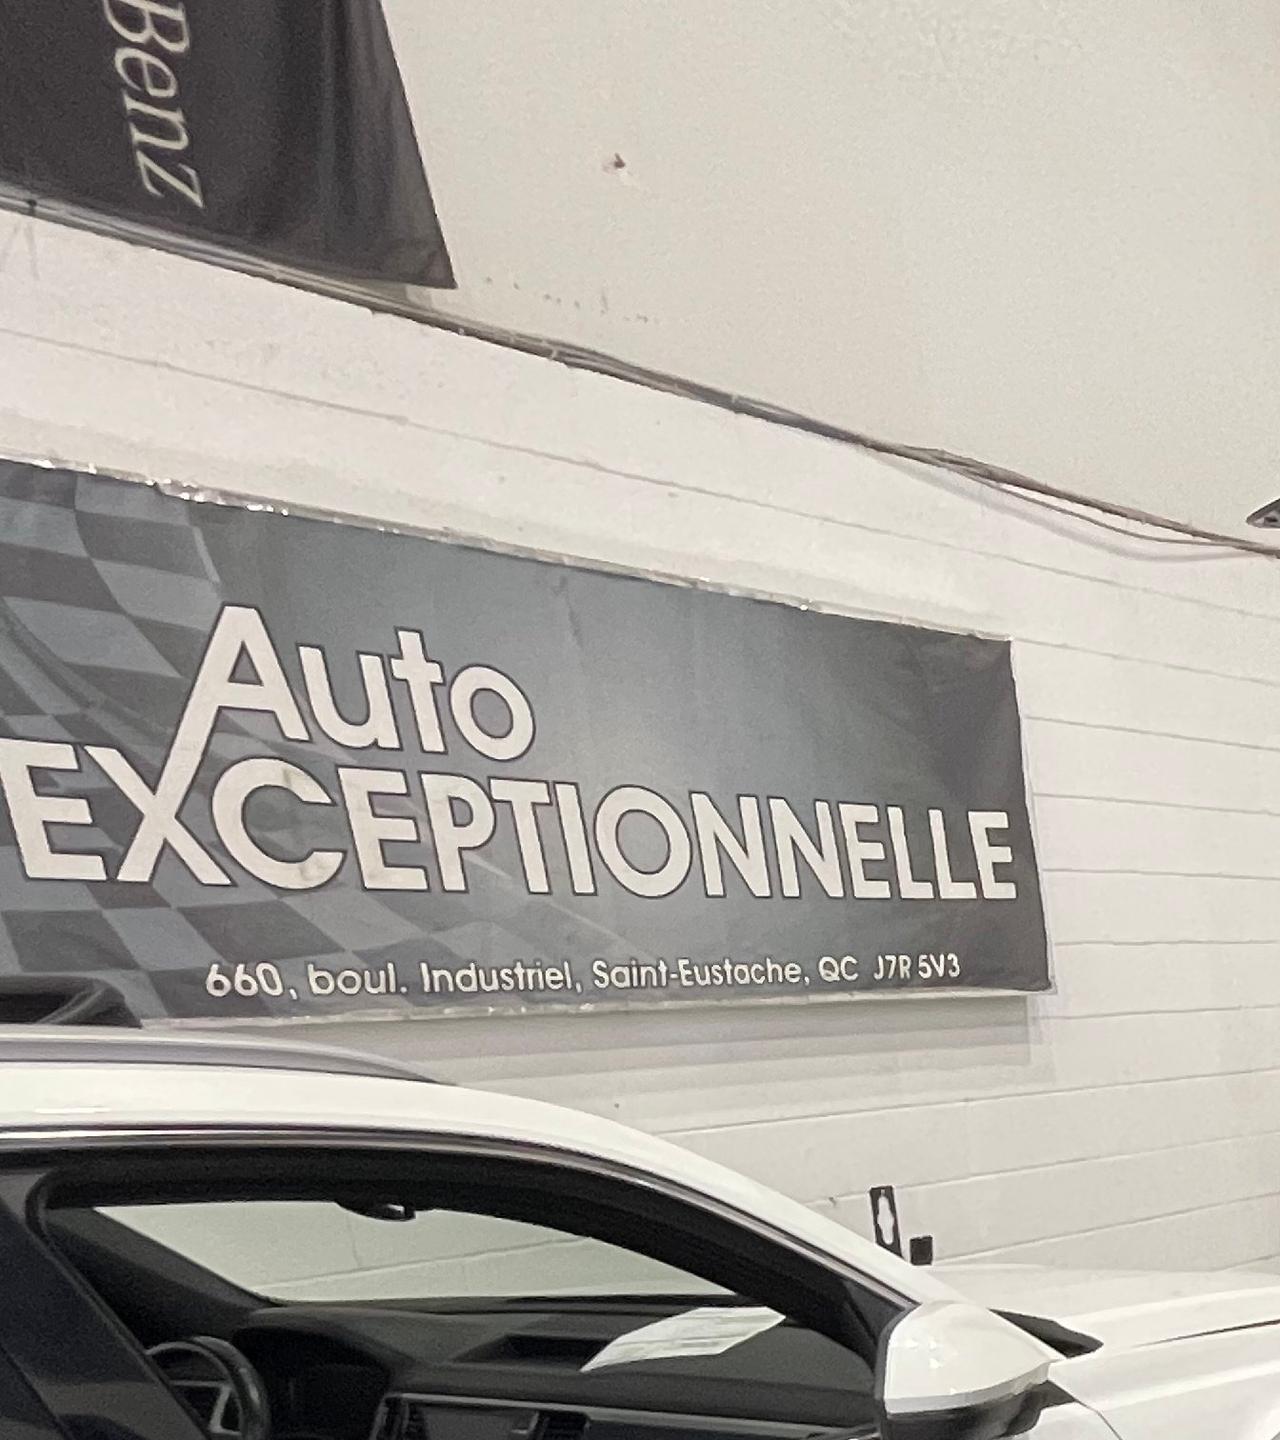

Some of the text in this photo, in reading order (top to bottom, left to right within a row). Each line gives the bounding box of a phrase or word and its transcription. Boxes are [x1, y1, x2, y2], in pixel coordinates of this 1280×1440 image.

[104, 0, 204, 209] Benz
[180, 605, 536, 760] Auto
[0, 737, 1017, 899] EXCEPTIONNELLE
[205, 953, 961, 1000] 660, boul. Industriel, Saint-Eustache, QC J7R 5V3
